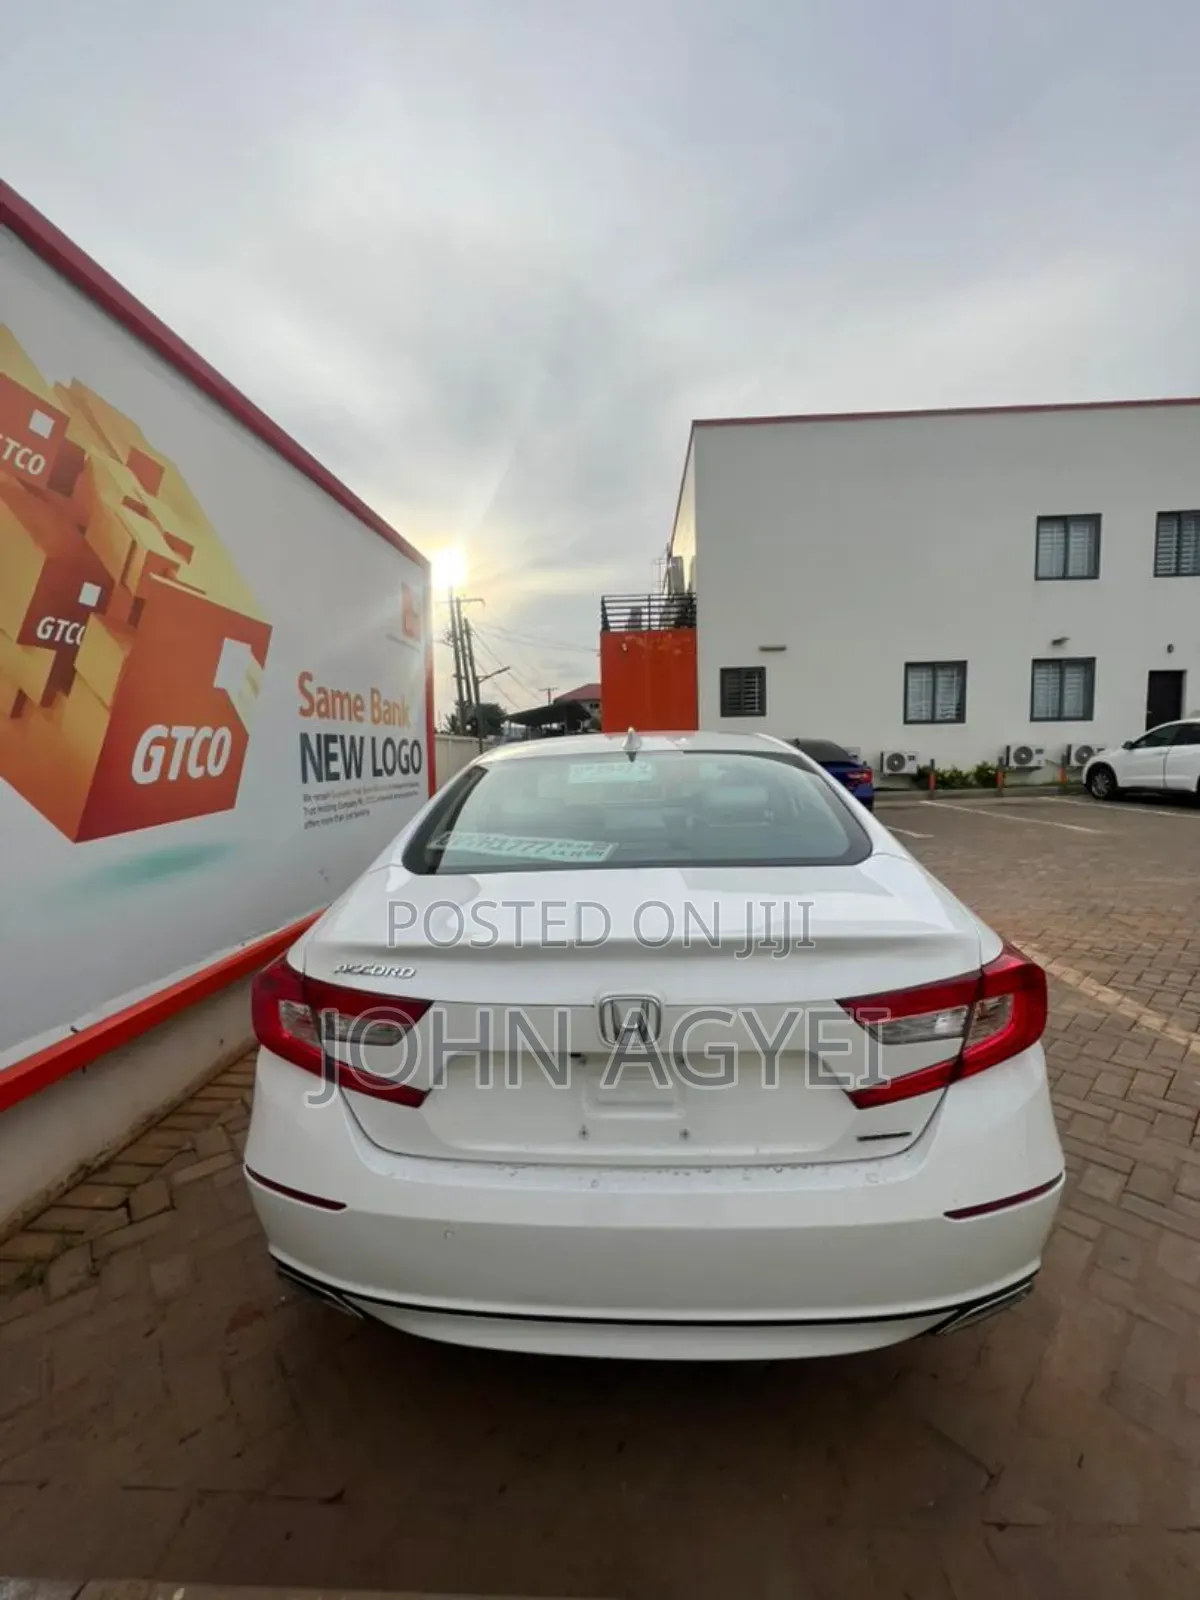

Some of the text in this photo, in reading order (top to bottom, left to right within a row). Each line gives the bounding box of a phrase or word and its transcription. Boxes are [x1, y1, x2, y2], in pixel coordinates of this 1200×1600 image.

[0, 433, 46, 476] TCO
[298, 670, 411, 728] Same Bank
[131, 723, 232, 785] GTCO
[300, 732, 422, 784] NEW LOGO
[334, 963, 417, 979] ACCORD
